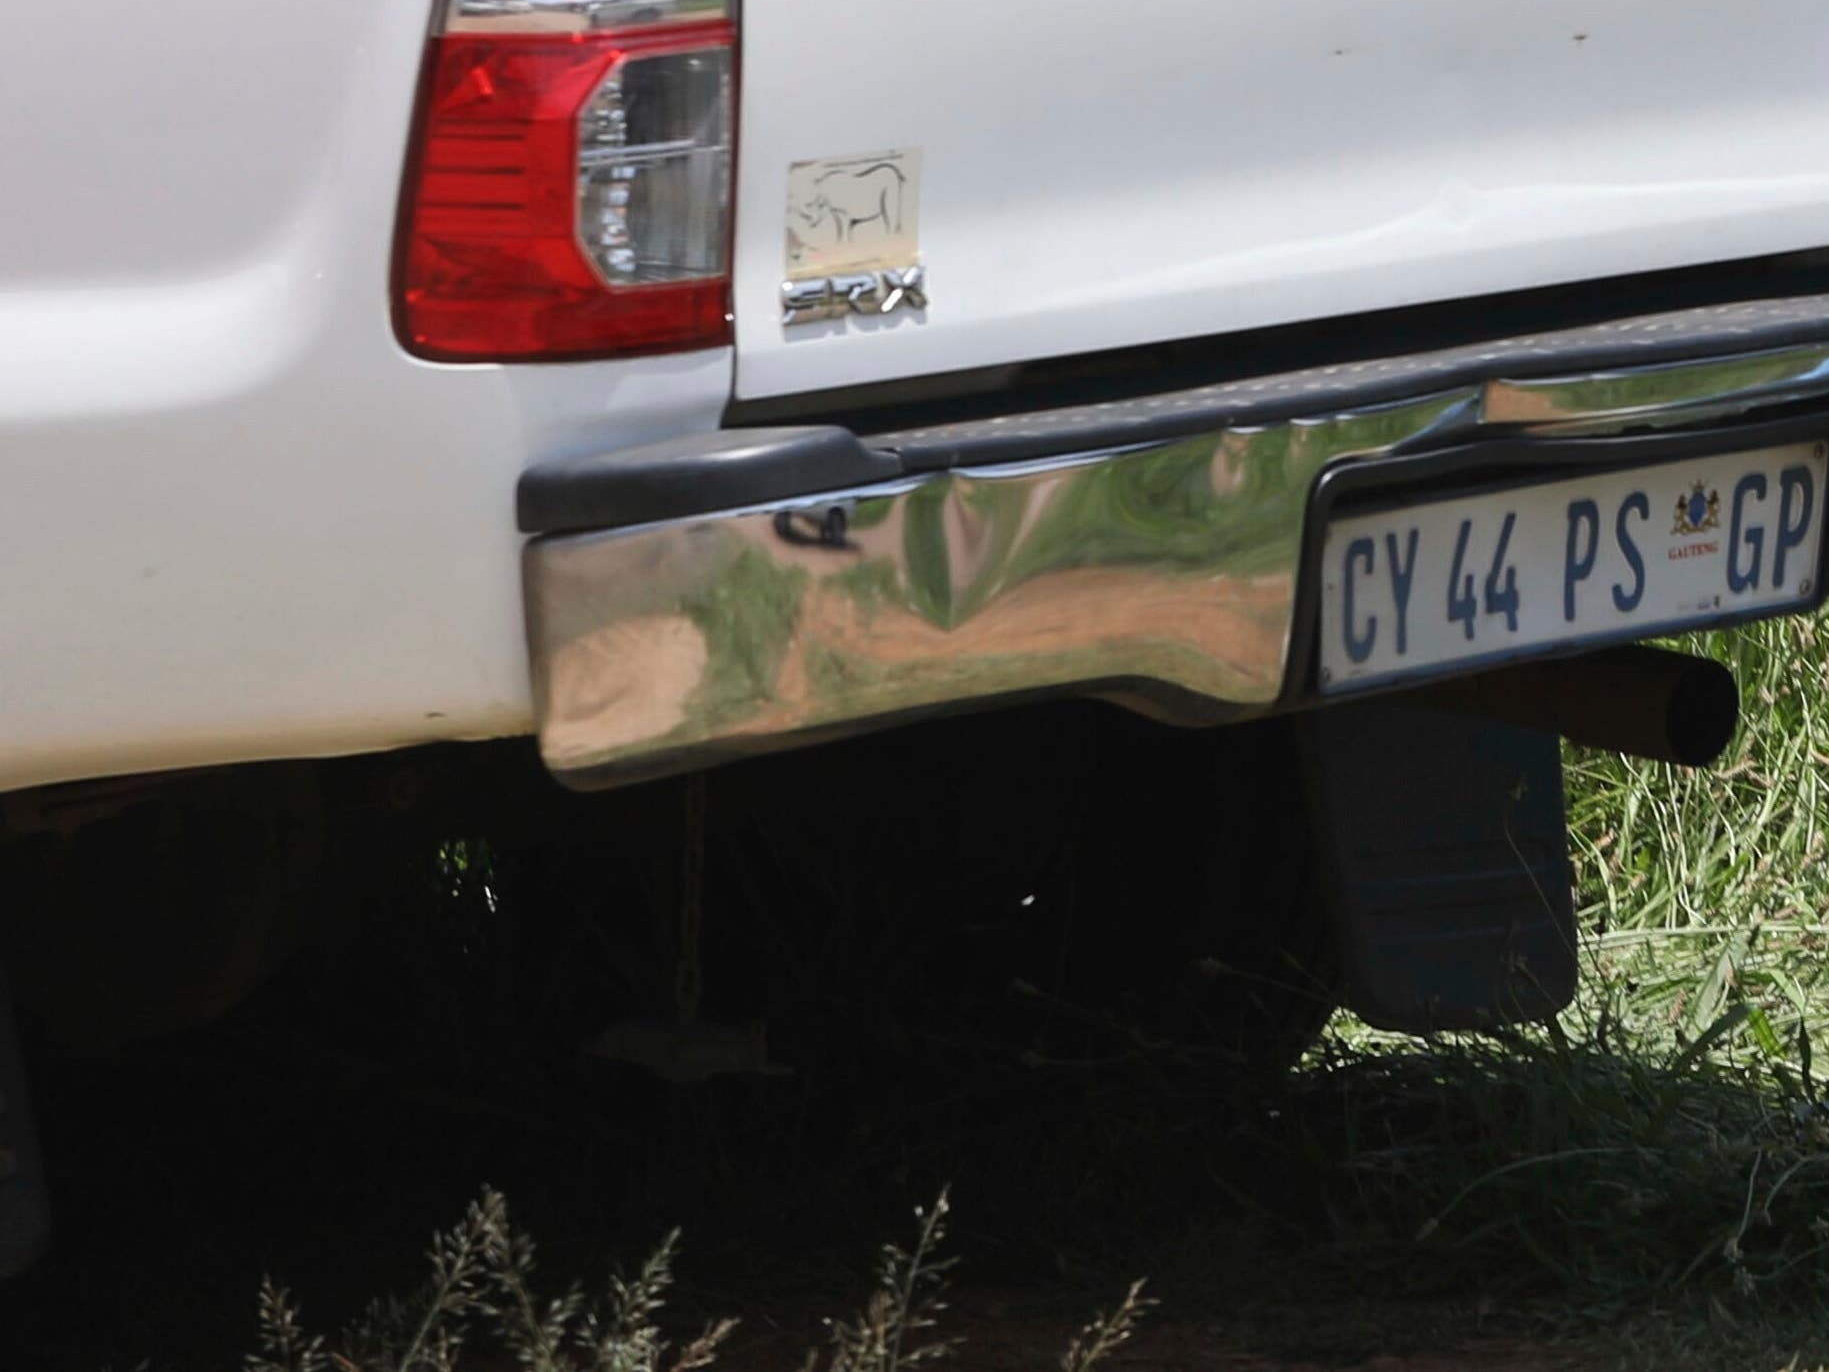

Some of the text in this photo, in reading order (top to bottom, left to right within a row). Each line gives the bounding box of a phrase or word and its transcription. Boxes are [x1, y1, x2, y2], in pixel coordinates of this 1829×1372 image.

[1342, 464, 1815, 665] CY 44 PS GP
